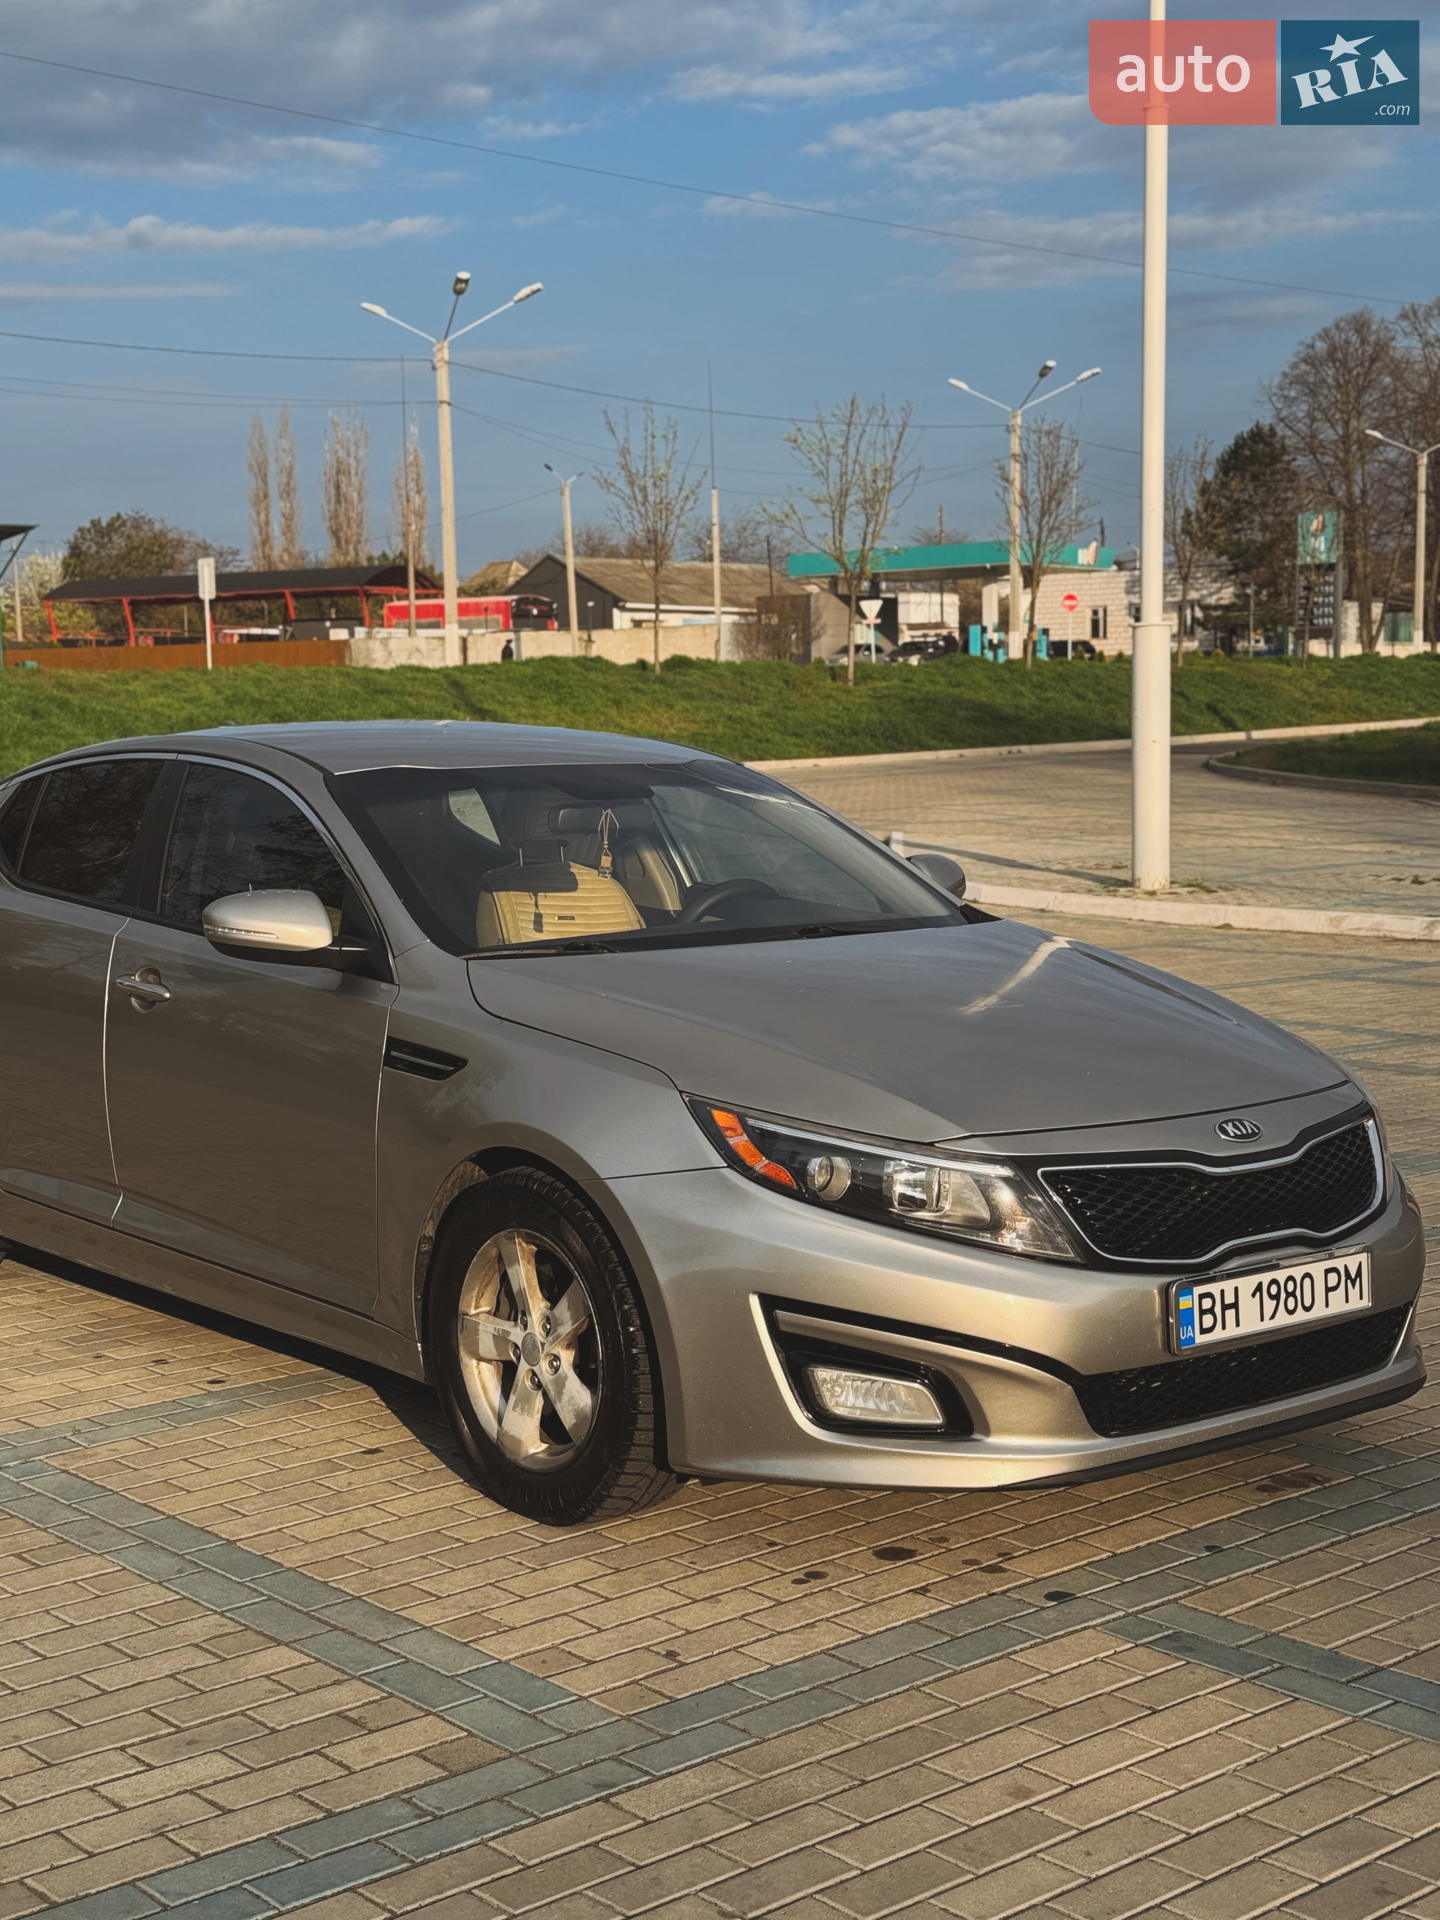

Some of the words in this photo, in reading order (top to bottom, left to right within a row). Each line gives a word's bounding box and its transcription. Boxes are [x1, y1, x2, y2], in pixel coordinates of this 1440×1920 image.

[1220, 1120, 1259, 1137] KIA
[1197, 1286, 1241, 1336] BH
[1251, 1271, 1316, 1323] 1980
[1324, 1260, 1364, 1309] PM
[1180, 1325, 1194, 1340] UA
